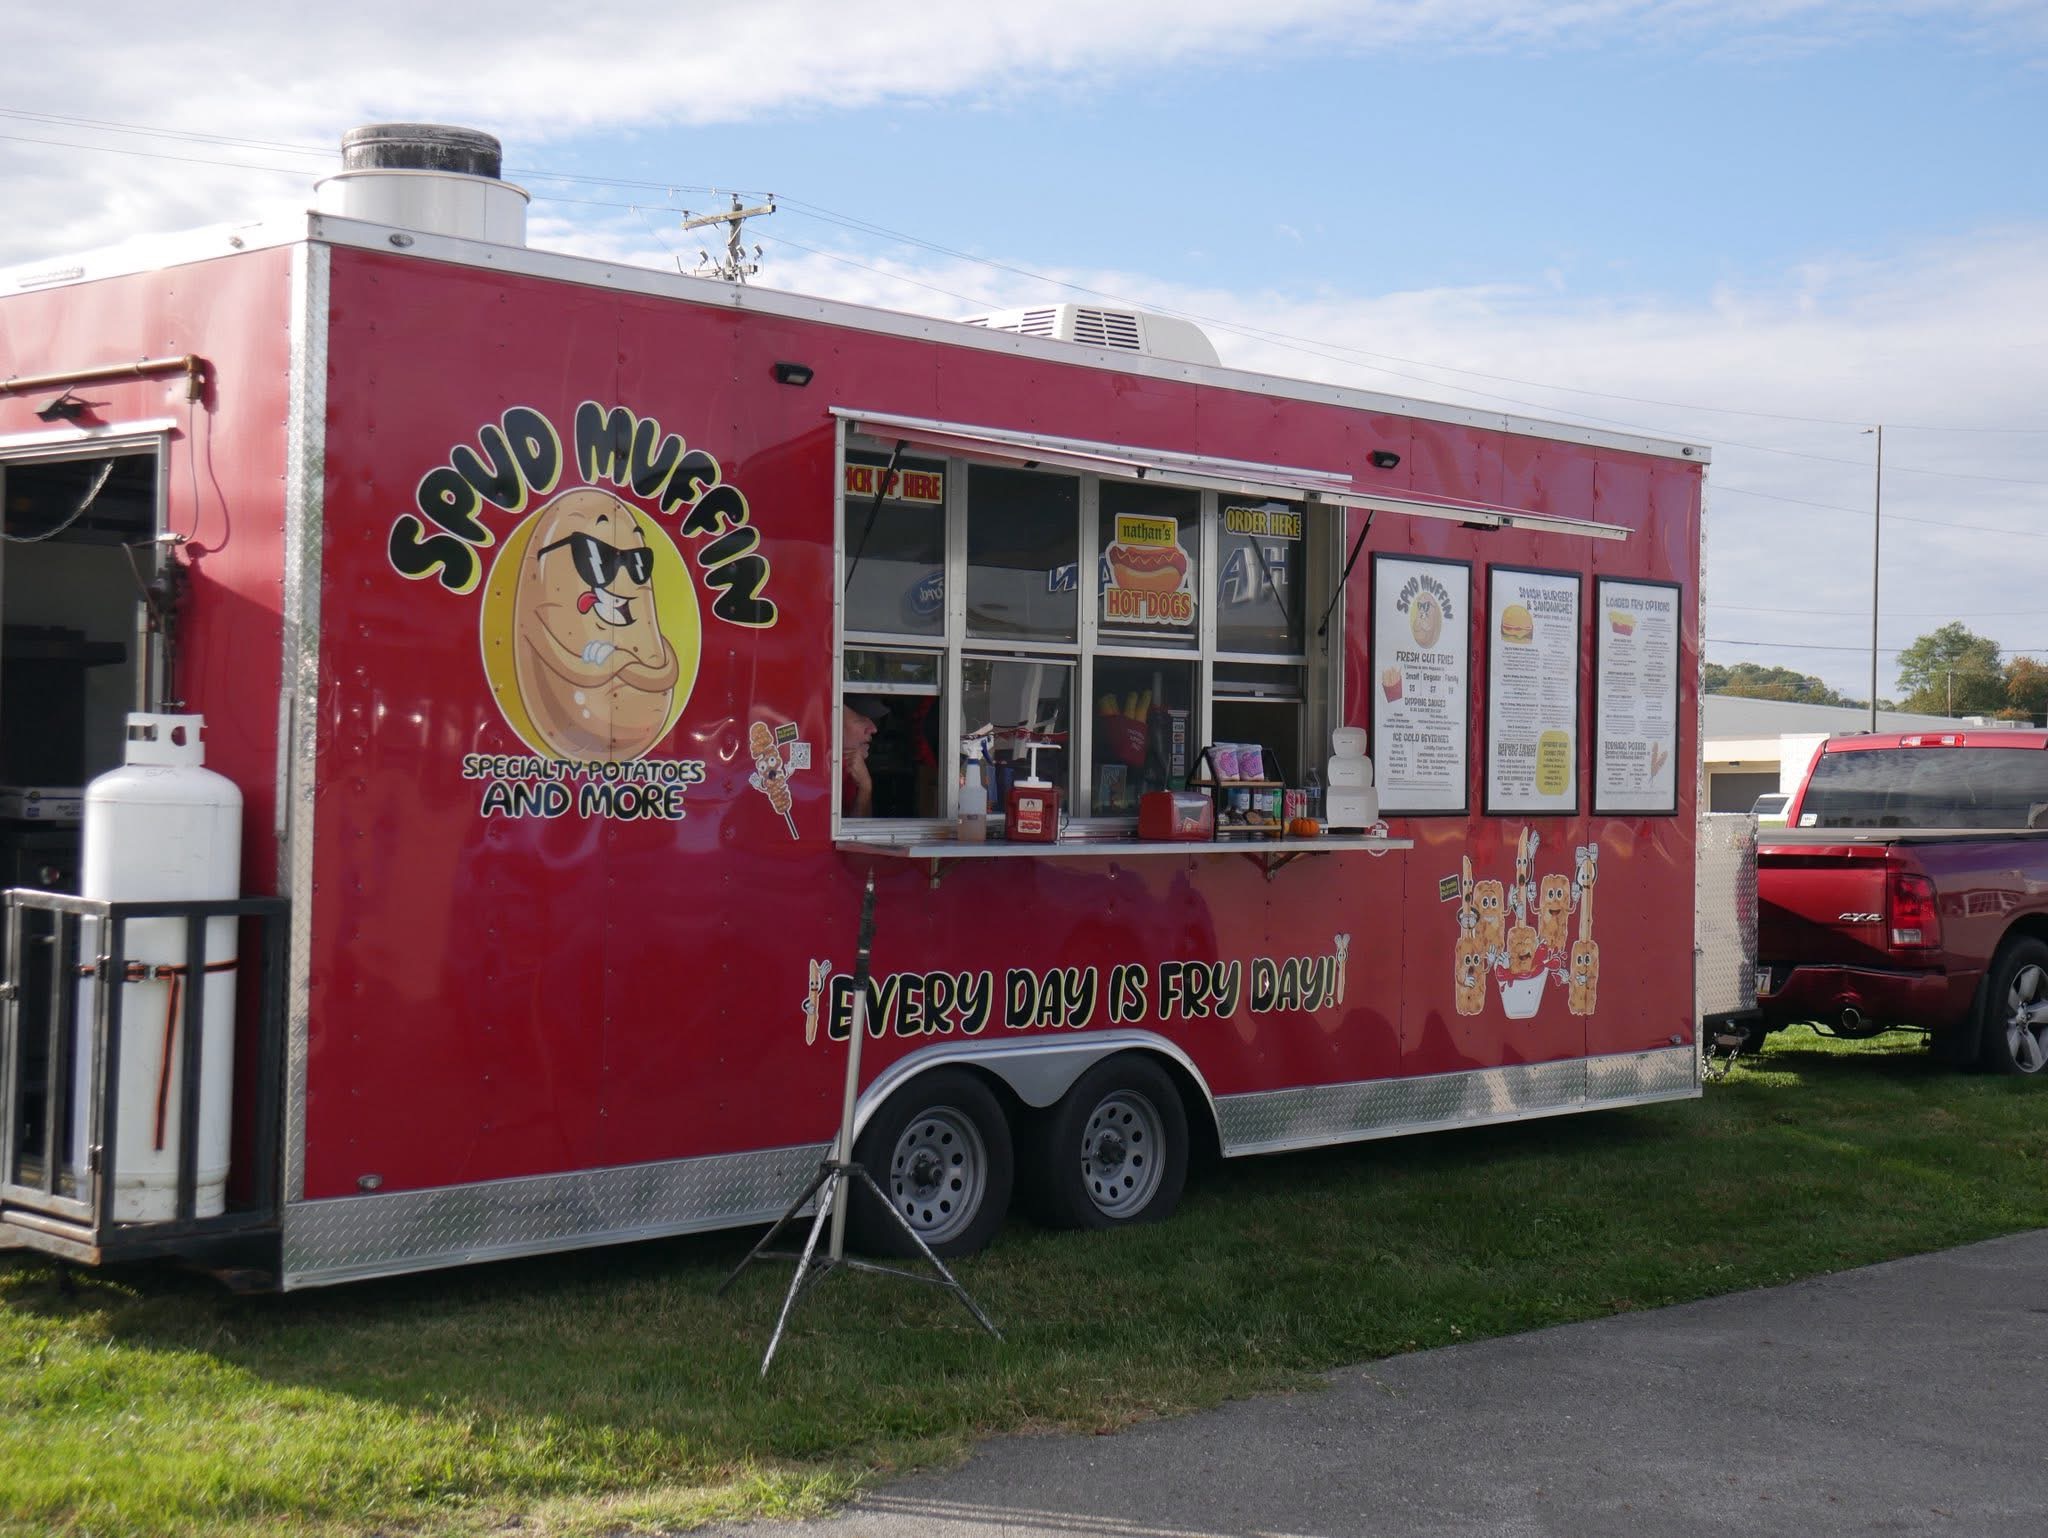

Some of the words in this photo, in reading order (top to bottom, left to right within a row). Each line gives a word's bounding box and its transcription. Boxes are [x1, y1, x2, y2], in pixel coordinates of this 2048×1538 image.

[903, 472, 940, 500] HERE
[388, 406, 563, 595] SPUD
[575, 400, 778, 628] MUFFIN
[1225, 507, 1267, 535] ORDER
[1269, 512, 1301, 538] HERE
[1123, 523, 1171, 541] nathan's
[1107, 588, 1143, 617] HOT
[1146, 591, 1192, 621] DOGS
[1543, 590, 1573, 603] BURGERS
[1396, 651, 1420, 663] FRESH
[1421, 653, 1436, 664] CUT
[1437, 654, 1454, 665] FRIES
[1392, 733, 1402, 742] ICE
[463, 754, 582, 779] SPECIALTY
[587, 759, 706, 784] POTATOES
[480, 783, 571, 819] AND
[578, 782, 687, 821] MORE
[827, 970, 993, 1042] EVERY
[1005, 966, 1098, 1030] DAY
[1109, 963, 1149, 1024] IS
[1158, 959, 1242, 1021] FRY
[1250, 954, 1336, 1014] DAY!
